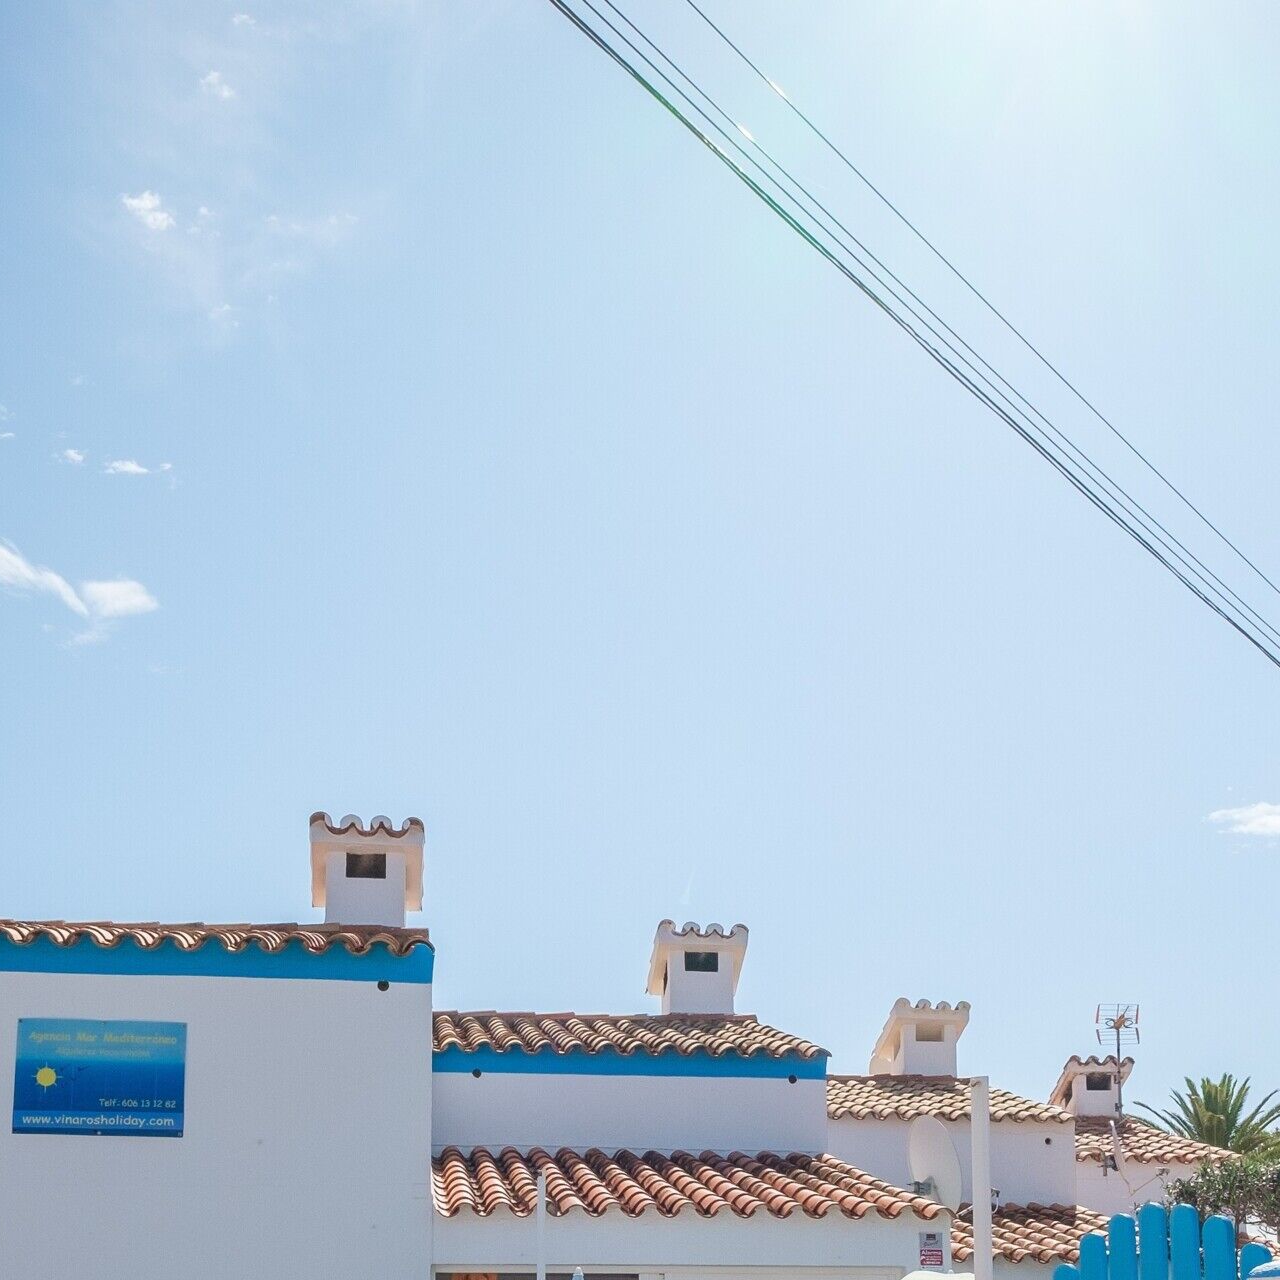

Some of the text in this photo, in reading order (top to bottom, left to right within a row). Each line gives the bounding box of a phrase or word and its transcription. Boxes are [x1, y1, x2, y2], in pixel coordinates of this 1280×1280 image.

[121, 1098, 138, 1108] 606
[141, 1099, 151, 1108] 13
[153, 1099, 163, 1108] 12
[23, 1114, 175, 1128] www.vinarosholiday.com
